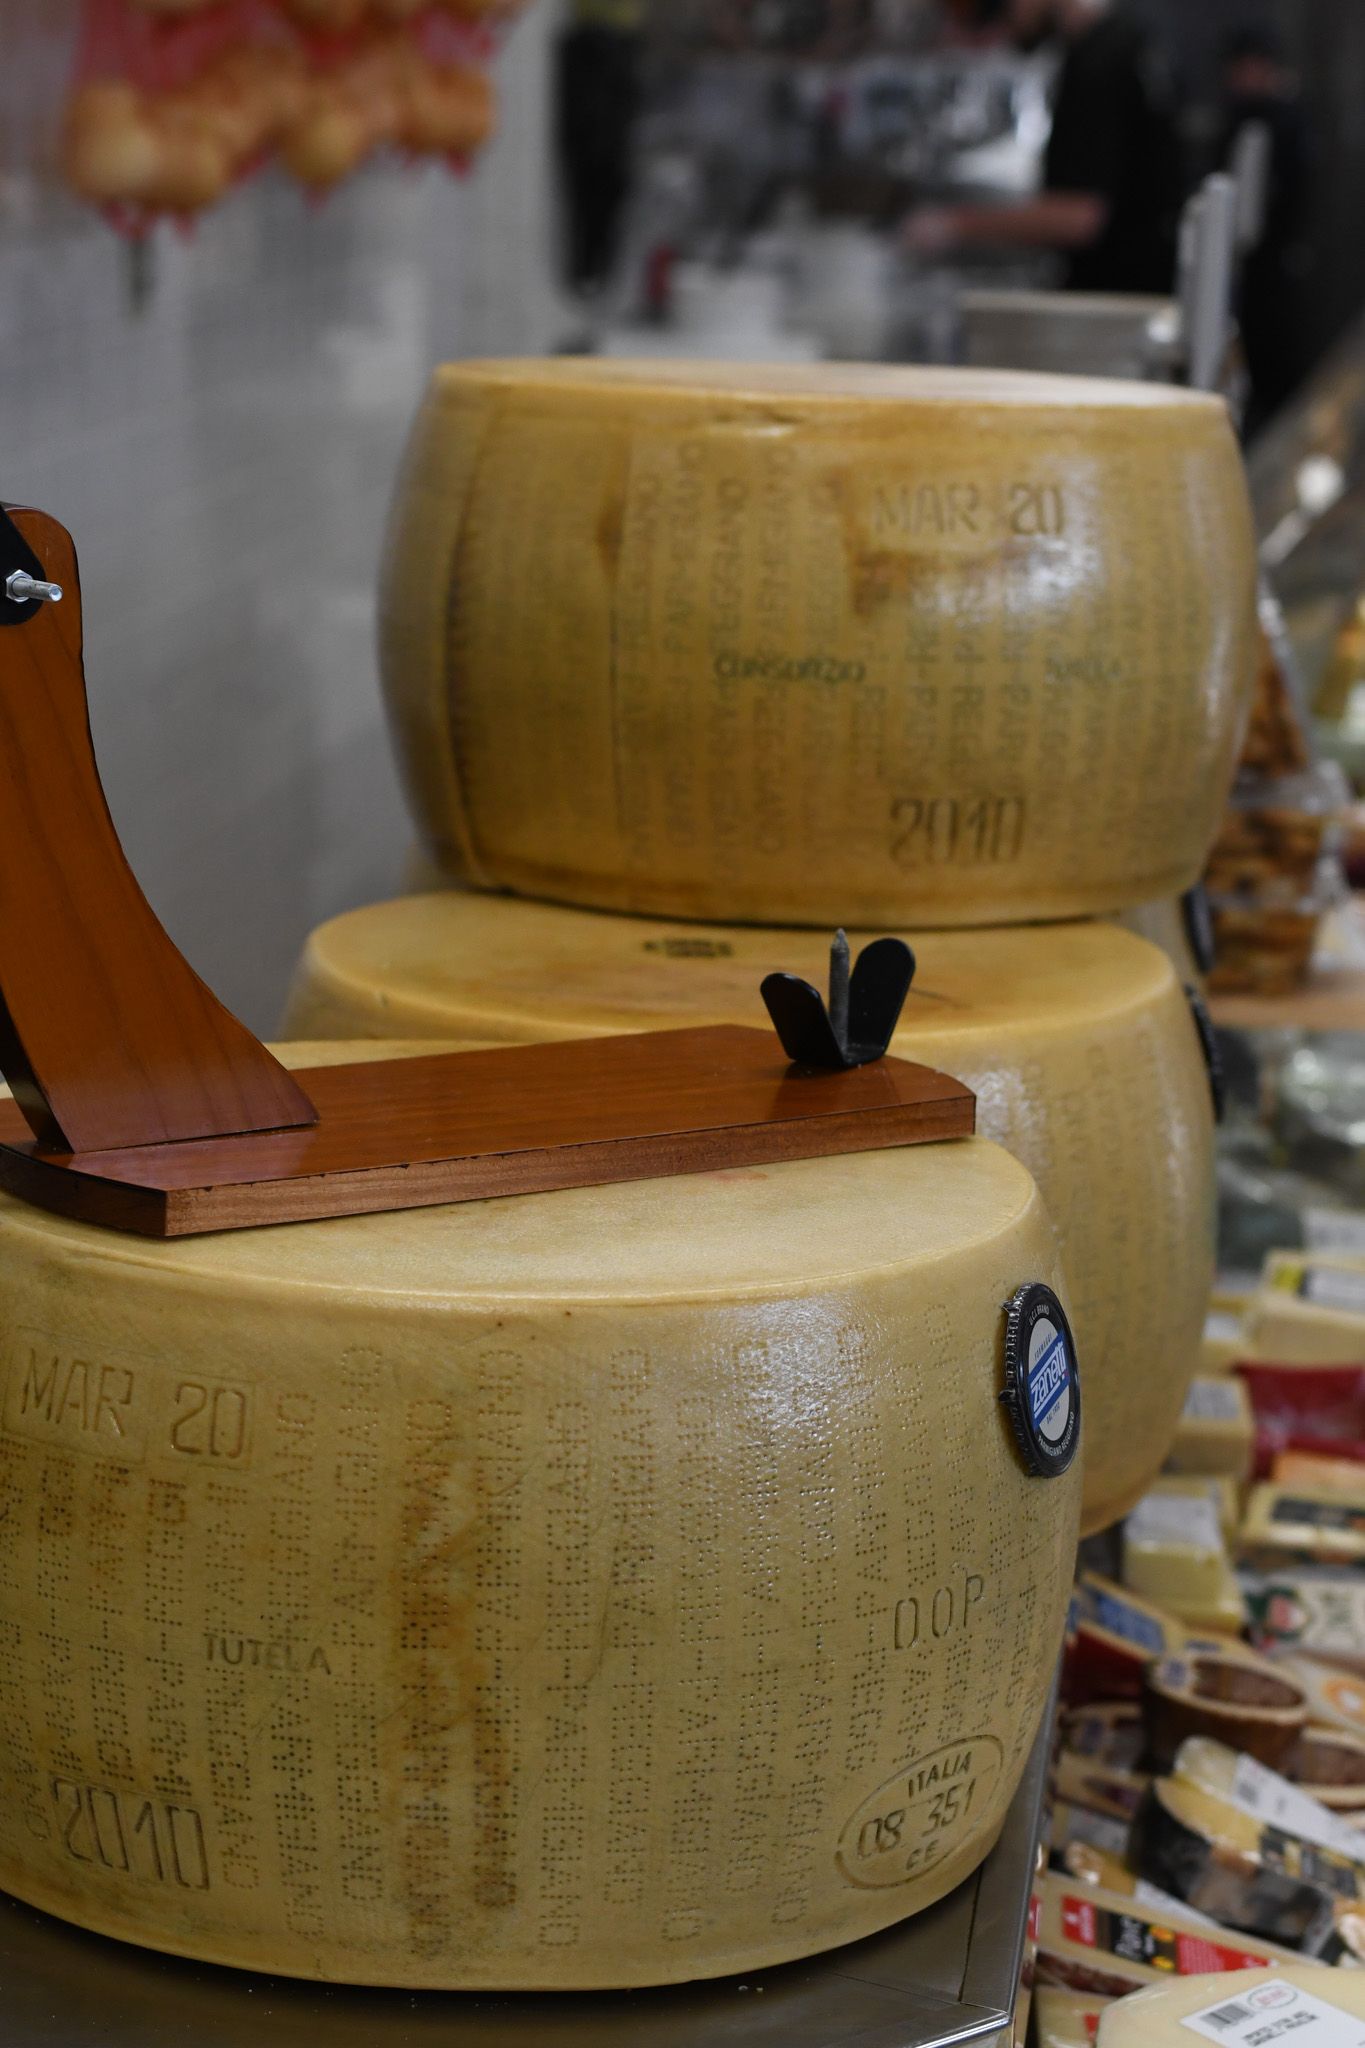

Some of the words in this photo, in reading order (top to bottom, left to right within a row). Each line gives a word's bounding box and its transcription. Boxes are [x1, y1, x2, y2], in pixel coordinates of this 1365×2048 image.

[873, 481, 979, 534] MAR
[1008, 481, 1065, 536] 20
[888, 796, 1027, 864] 2010
[22, 1347, 135, 1437] MAR
[171, 1381, 248, 1460] 20
[1031, 1341, 1067, 1412] zanetti
[203, 1632, 332, 1676] TUTELA
[907, 1751, 973, 1800] ITALIA
[53, 1779, 211, 1892] 2010
[857, 1808, 907, 1860] 08
[922, 1777, 978, 1838] 351
[906, 1839, 941, 1872] CE
